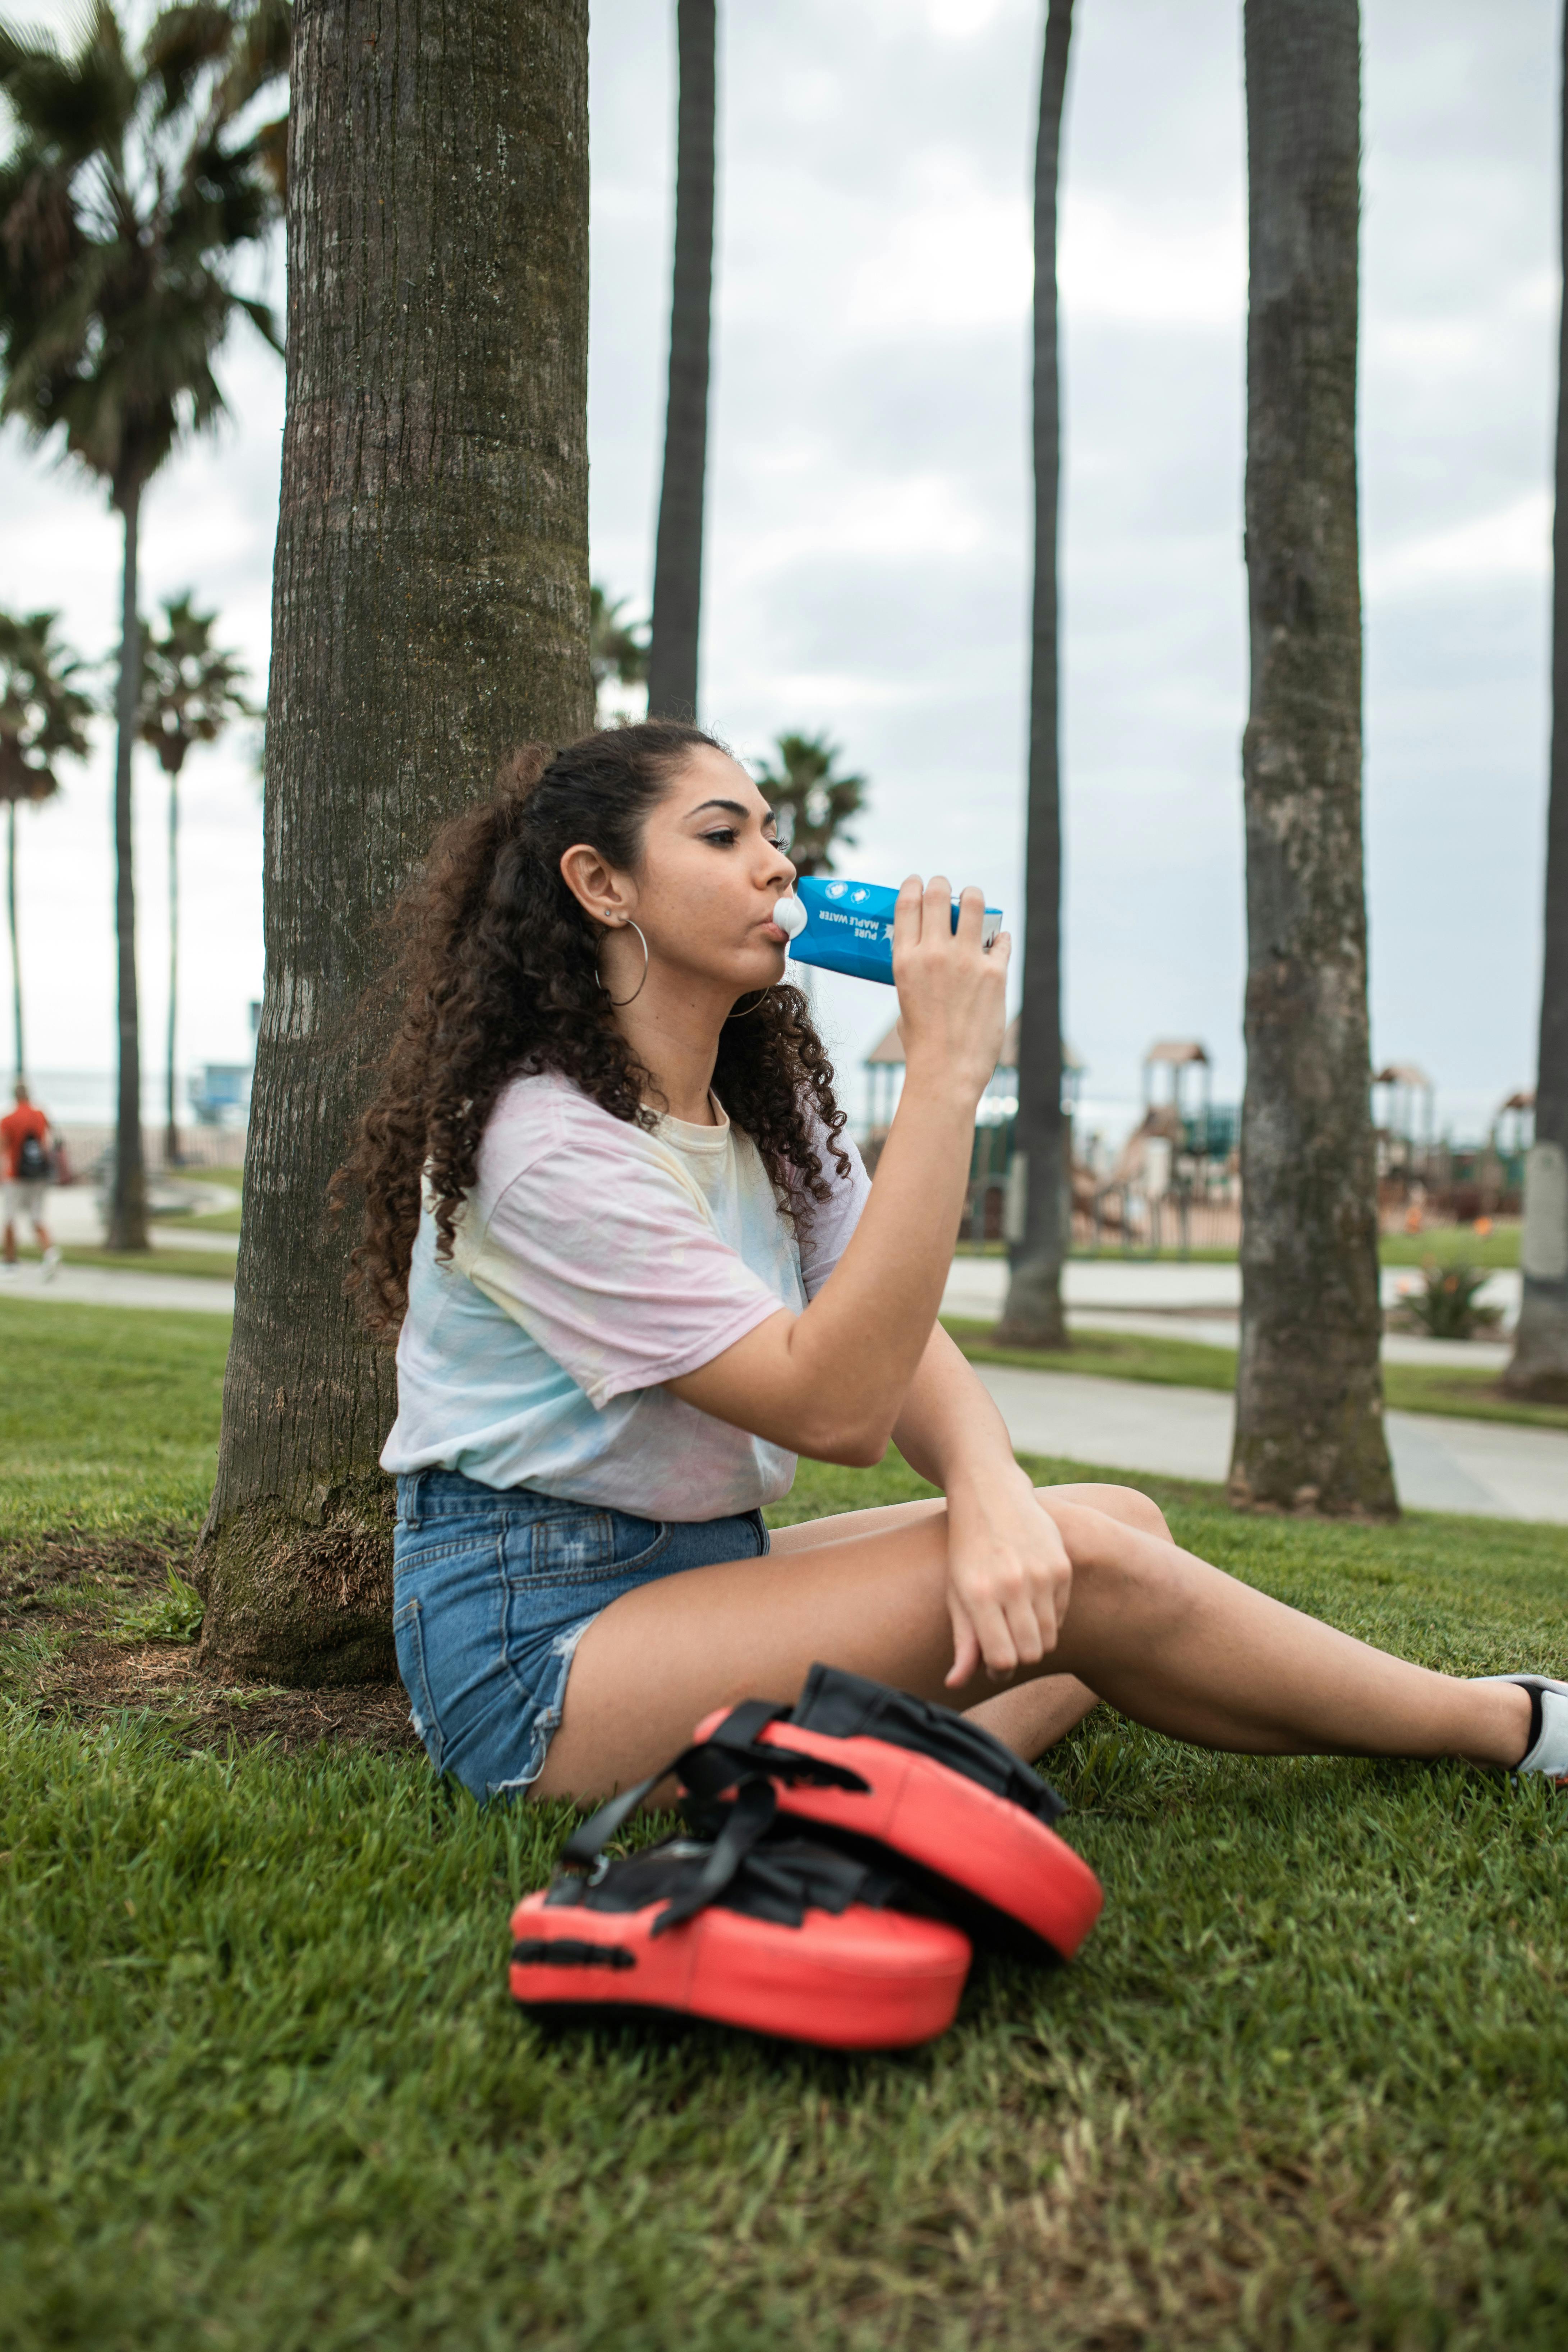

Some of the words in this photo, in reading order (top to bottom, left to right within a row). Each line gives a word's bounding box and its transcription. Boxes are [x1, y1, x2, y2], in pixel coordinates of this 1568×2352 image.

[819, 910, 848, 924] WATER
[850, 917, 879, 930] MAPLE
[855, 928, 877, 940] PURE
